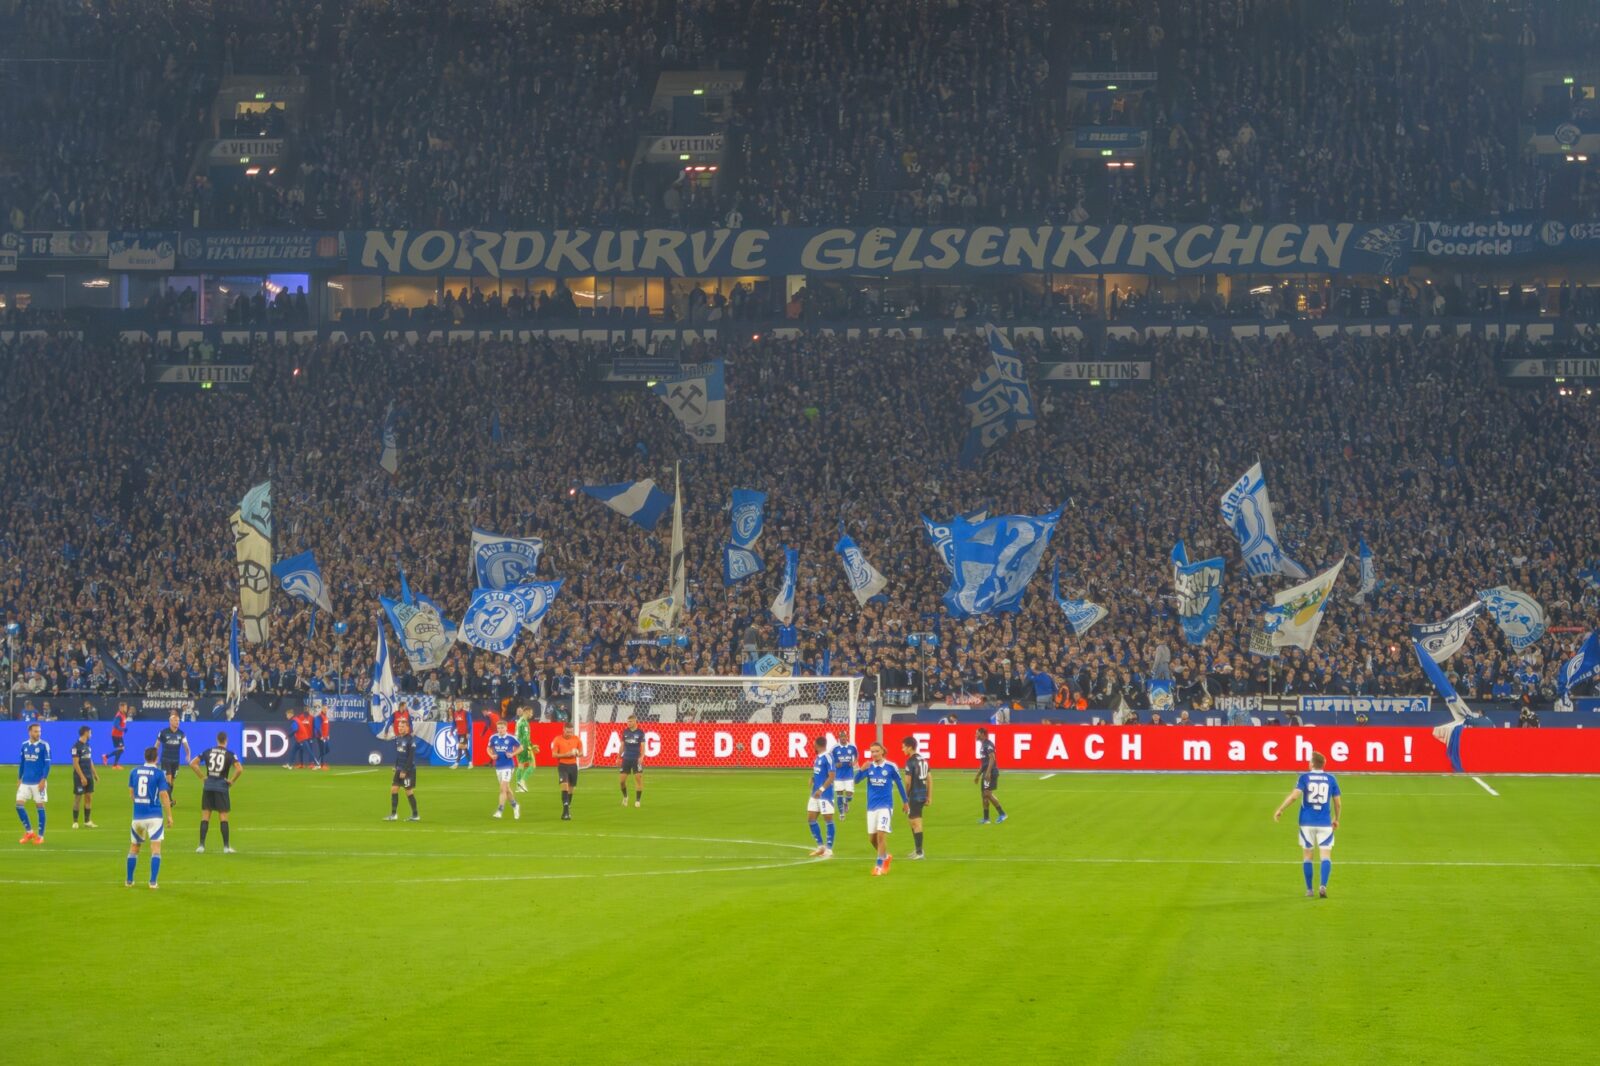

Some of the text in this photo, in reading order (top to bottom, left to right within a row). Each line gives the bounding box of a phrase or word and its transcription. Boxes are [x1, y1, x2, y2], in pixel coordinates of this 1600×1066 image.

[231, 143, 283, 154] VELTINS
[671, 139, 721, 151] VELTINS
[207, 245, 312, 260] HAMBURG
[361, 223, 1354, 277] NORDKURVE GELSENKIRCHEN
[188, 367, 249, 381] VELTINS
[1076, 363, 1140, 379] VELTINS
[1543, 360, 1600, 376] ELTIN
[1183, 735, 1413, 762] machen!
[208, 752, 225, 772] 39
[918, 760, 929, 779] 10
[137, 775, 149, 797] 6
[1307, 781, 1329, 804] 29
